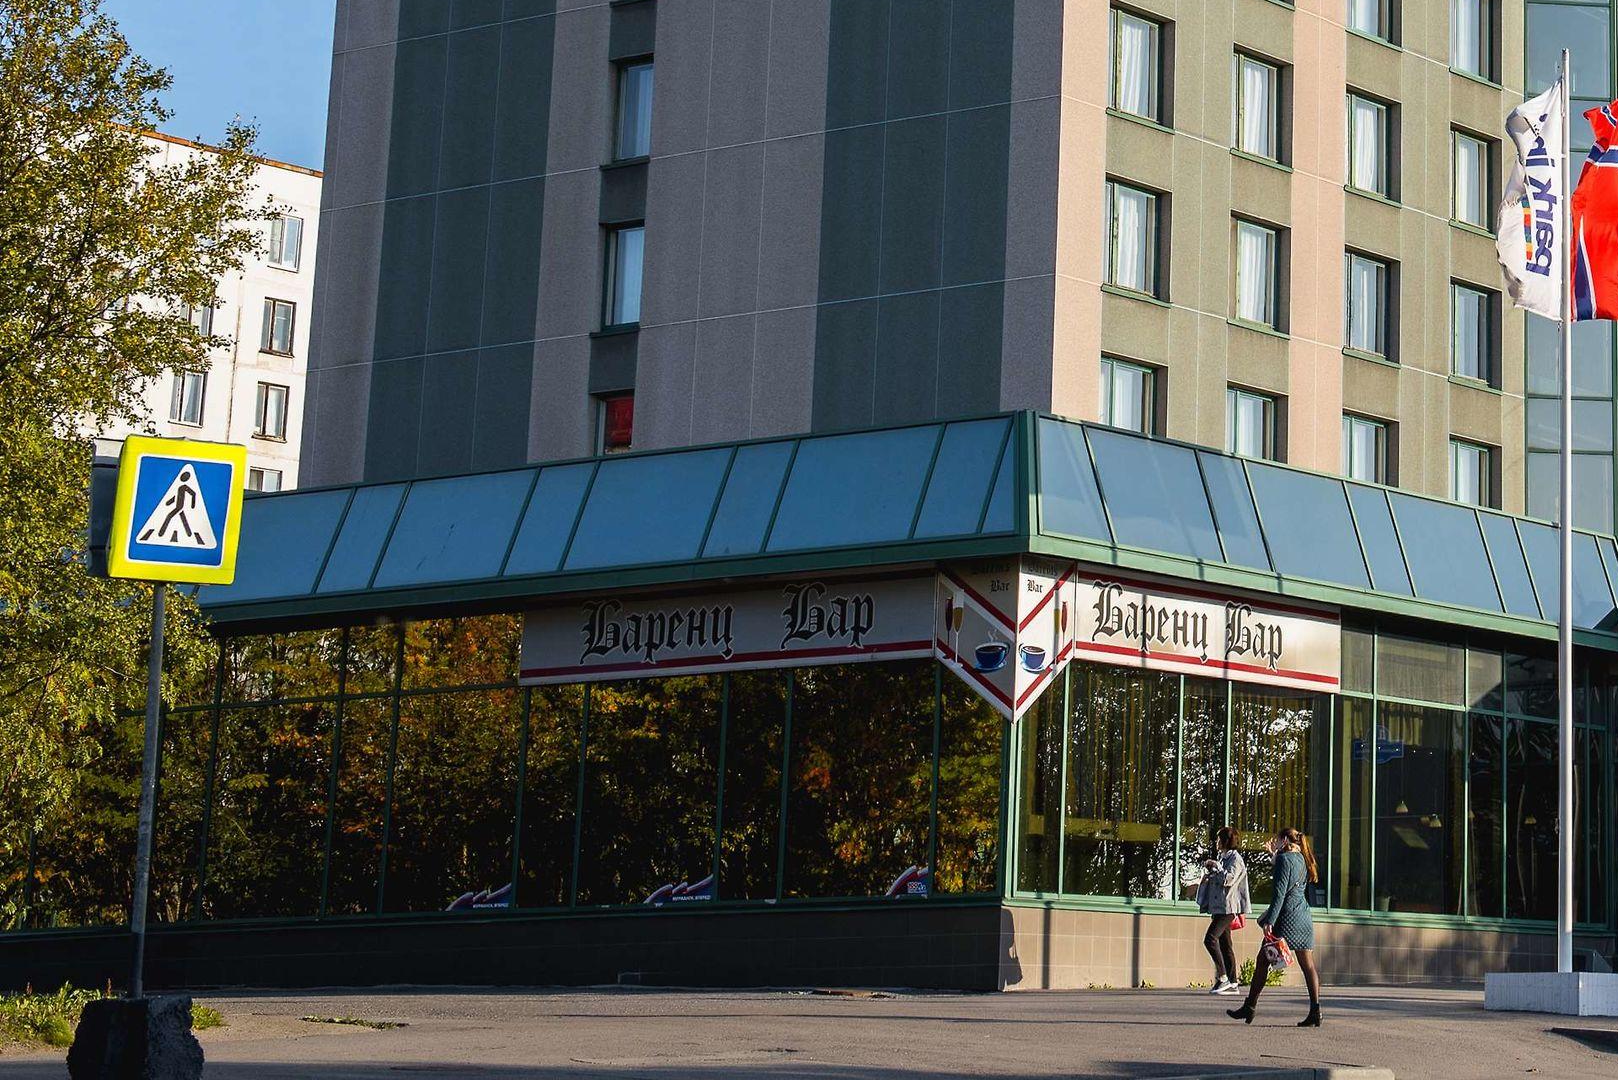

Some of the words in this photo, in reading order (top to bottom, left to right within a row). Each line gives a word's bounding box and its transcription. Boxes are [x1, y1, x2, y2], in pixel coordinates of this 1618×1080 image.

[580, 598, 735, 665] Баренц
[780, 581, 876, 651] Бар
[1091, 580, 1209, 664] Баренц
[1224, 599, 1285, 673] Бар
